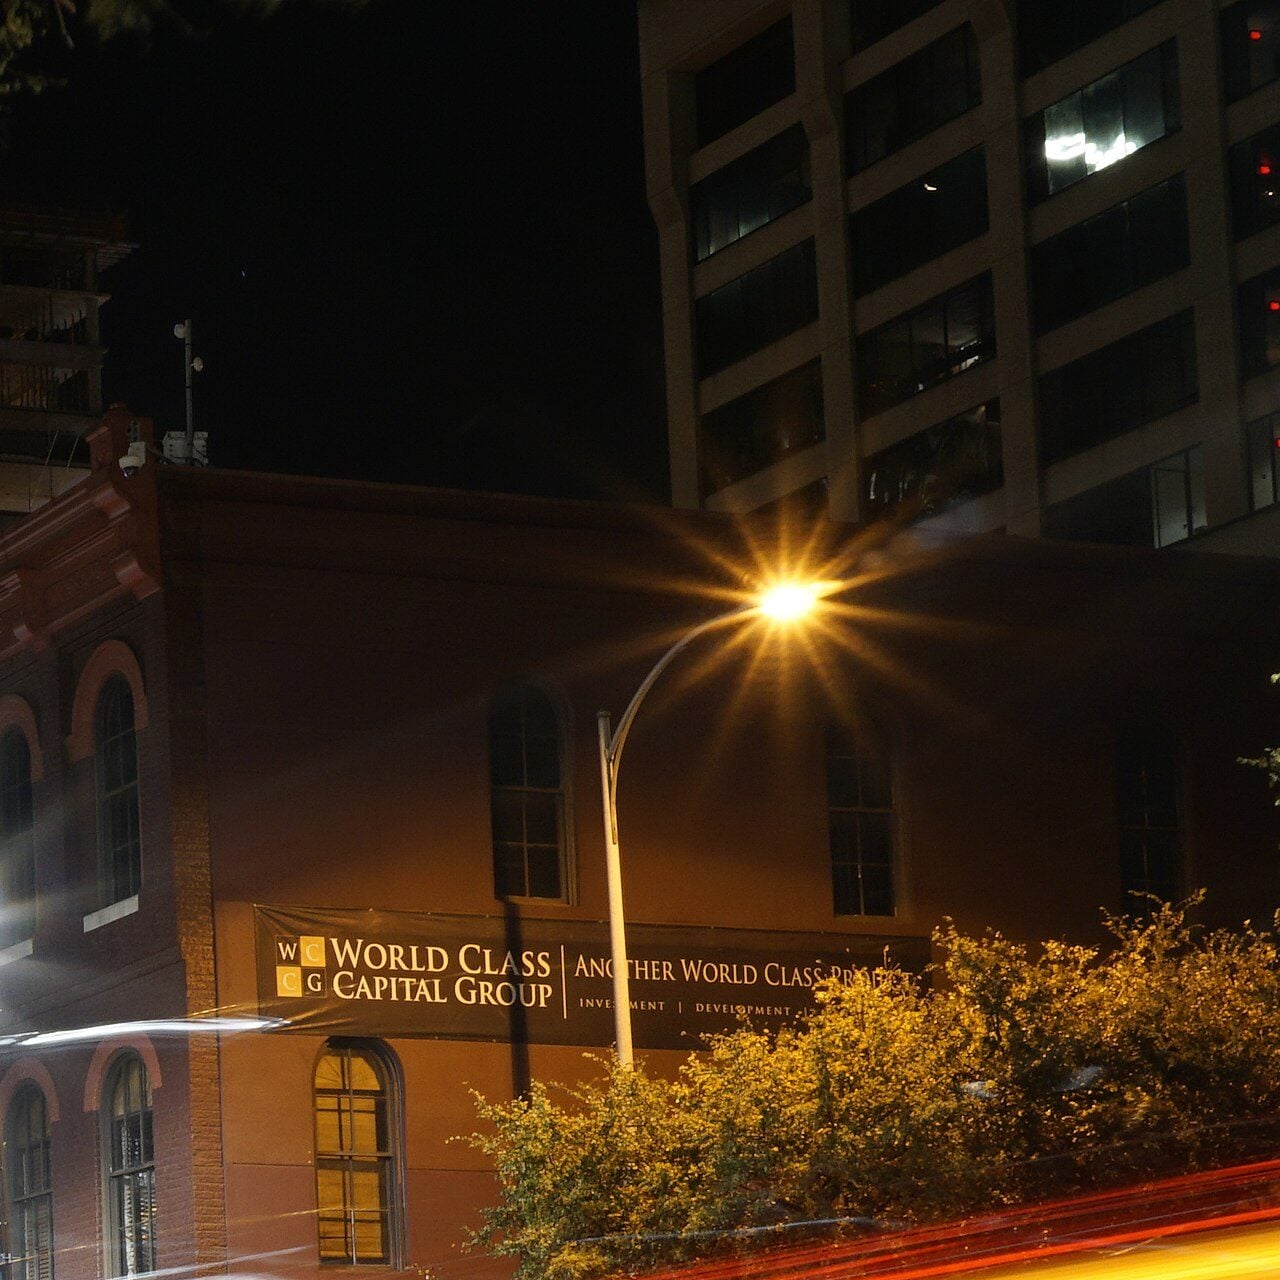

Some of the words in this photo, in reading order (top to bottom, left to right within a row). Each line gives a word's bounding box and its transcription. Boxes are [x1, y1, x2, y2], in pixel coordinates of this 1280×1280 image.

[330, 938, 448, 972] WORLD
[458, 943, 551, 978] CLASS
[680, 958, 758, 987] WORLD
[764, 962, 822, 989] CLASS
[333, 971, 448, 1003] CAPITAL
[454, 976, 553, 1008] GROUP
[580, 998, 665, 1011] INVEMENT
[696, 1003, 791, 1016] DEVELOPMENT
